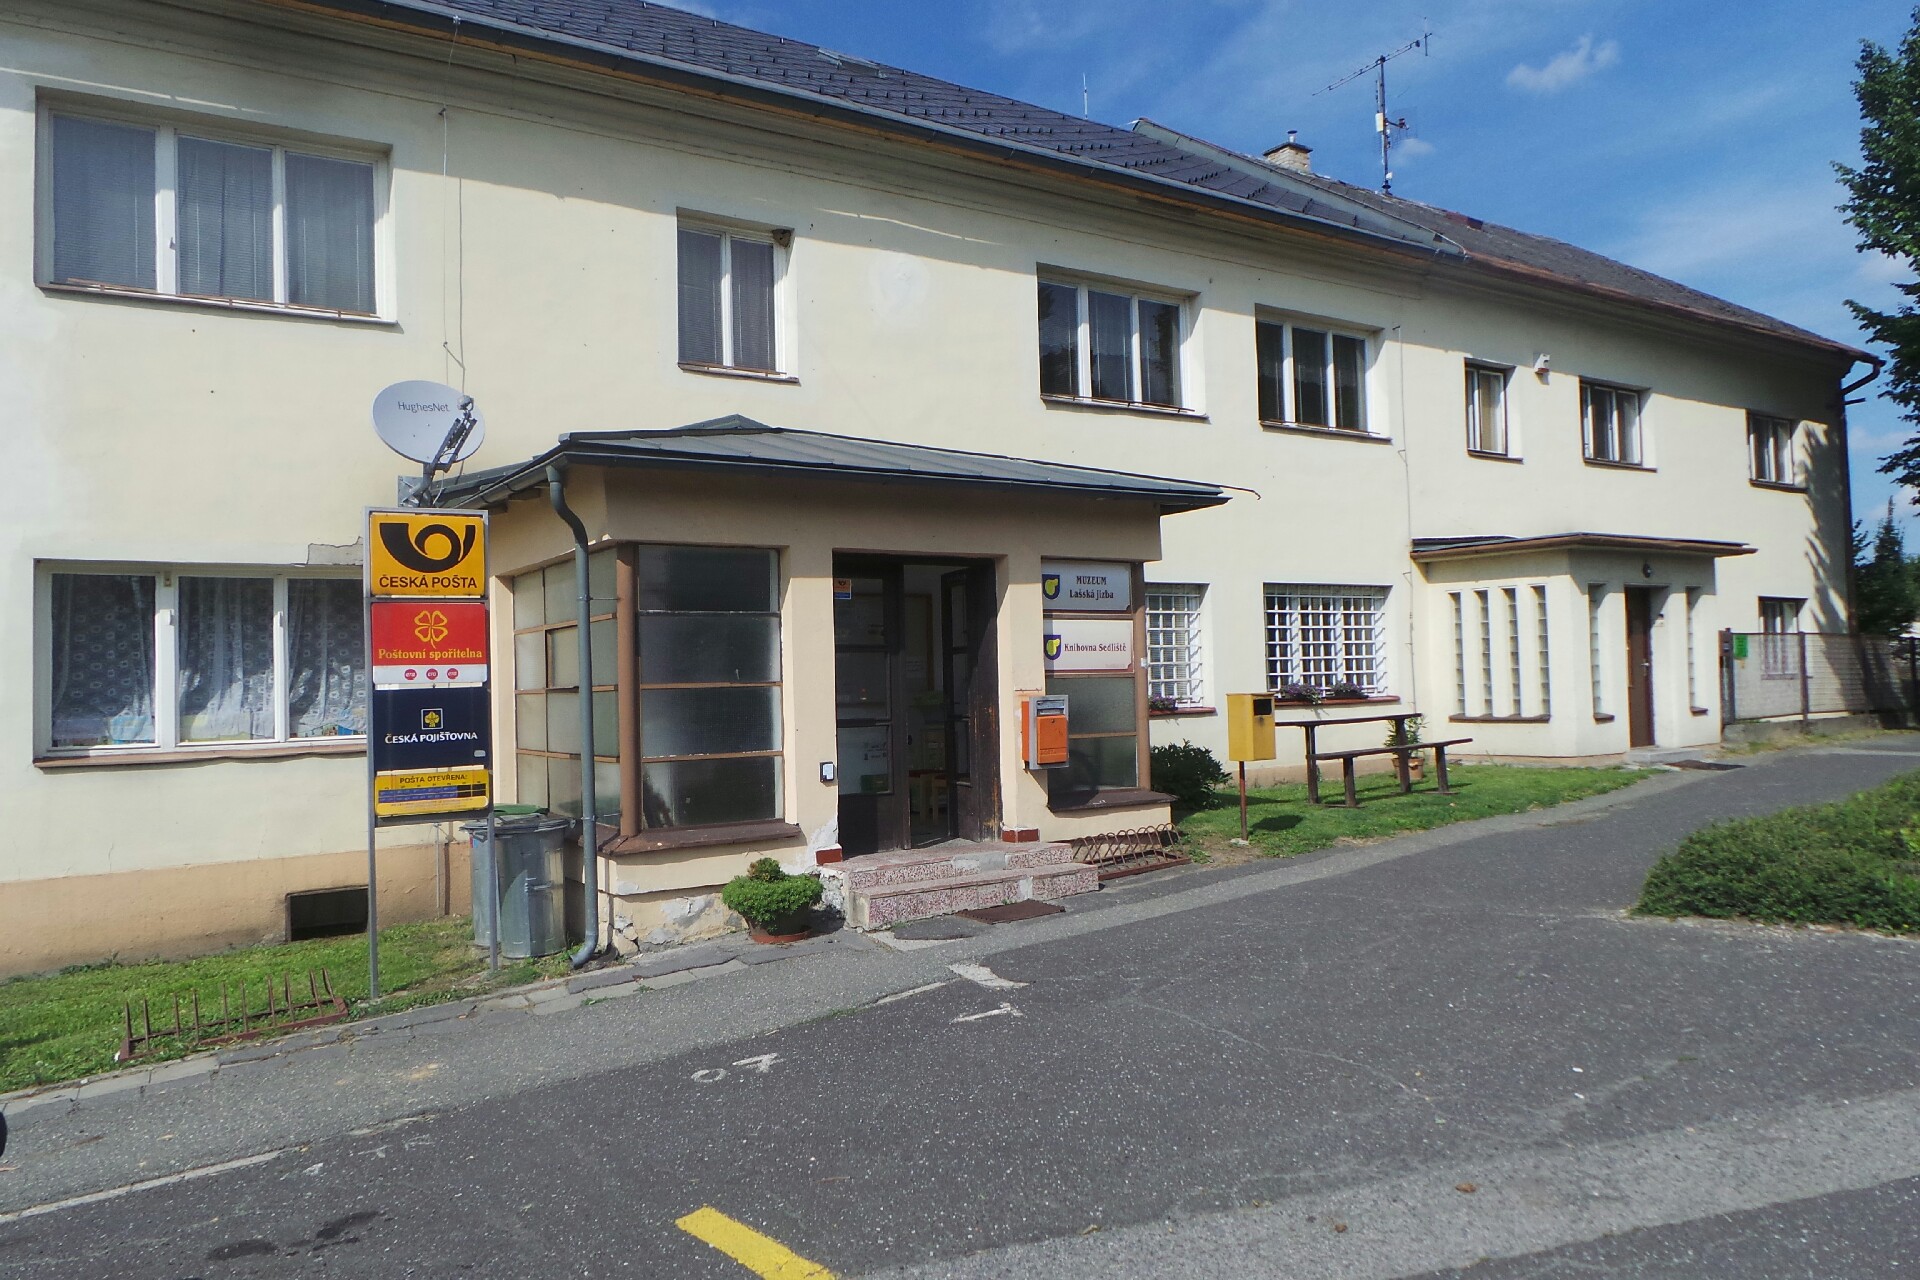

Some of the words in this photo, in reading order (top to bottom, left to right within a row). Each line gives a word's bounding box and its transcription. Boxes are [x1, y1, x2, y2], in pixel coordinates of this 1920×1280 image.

[398, 401, 450, 413] HughesNet
[379, 575, 428, 588] ČESKÁ
[432, 575, 477, 588] POŠTA
[1076, 576, 1107, 585] MUZEUM
[1064, 643, 1097, 652] Knihovna
[1098, 643, 1127, 652] Sedliště
[378, 648, 426, 659] Poštovní
[429, 648, 482, 660] spořitelna
[384, 733, 419, 744] ČESKÁ
[419, 731, 478, 743] POJIŠŤOVNA
[399, 775, 425, 784] POŠTA
